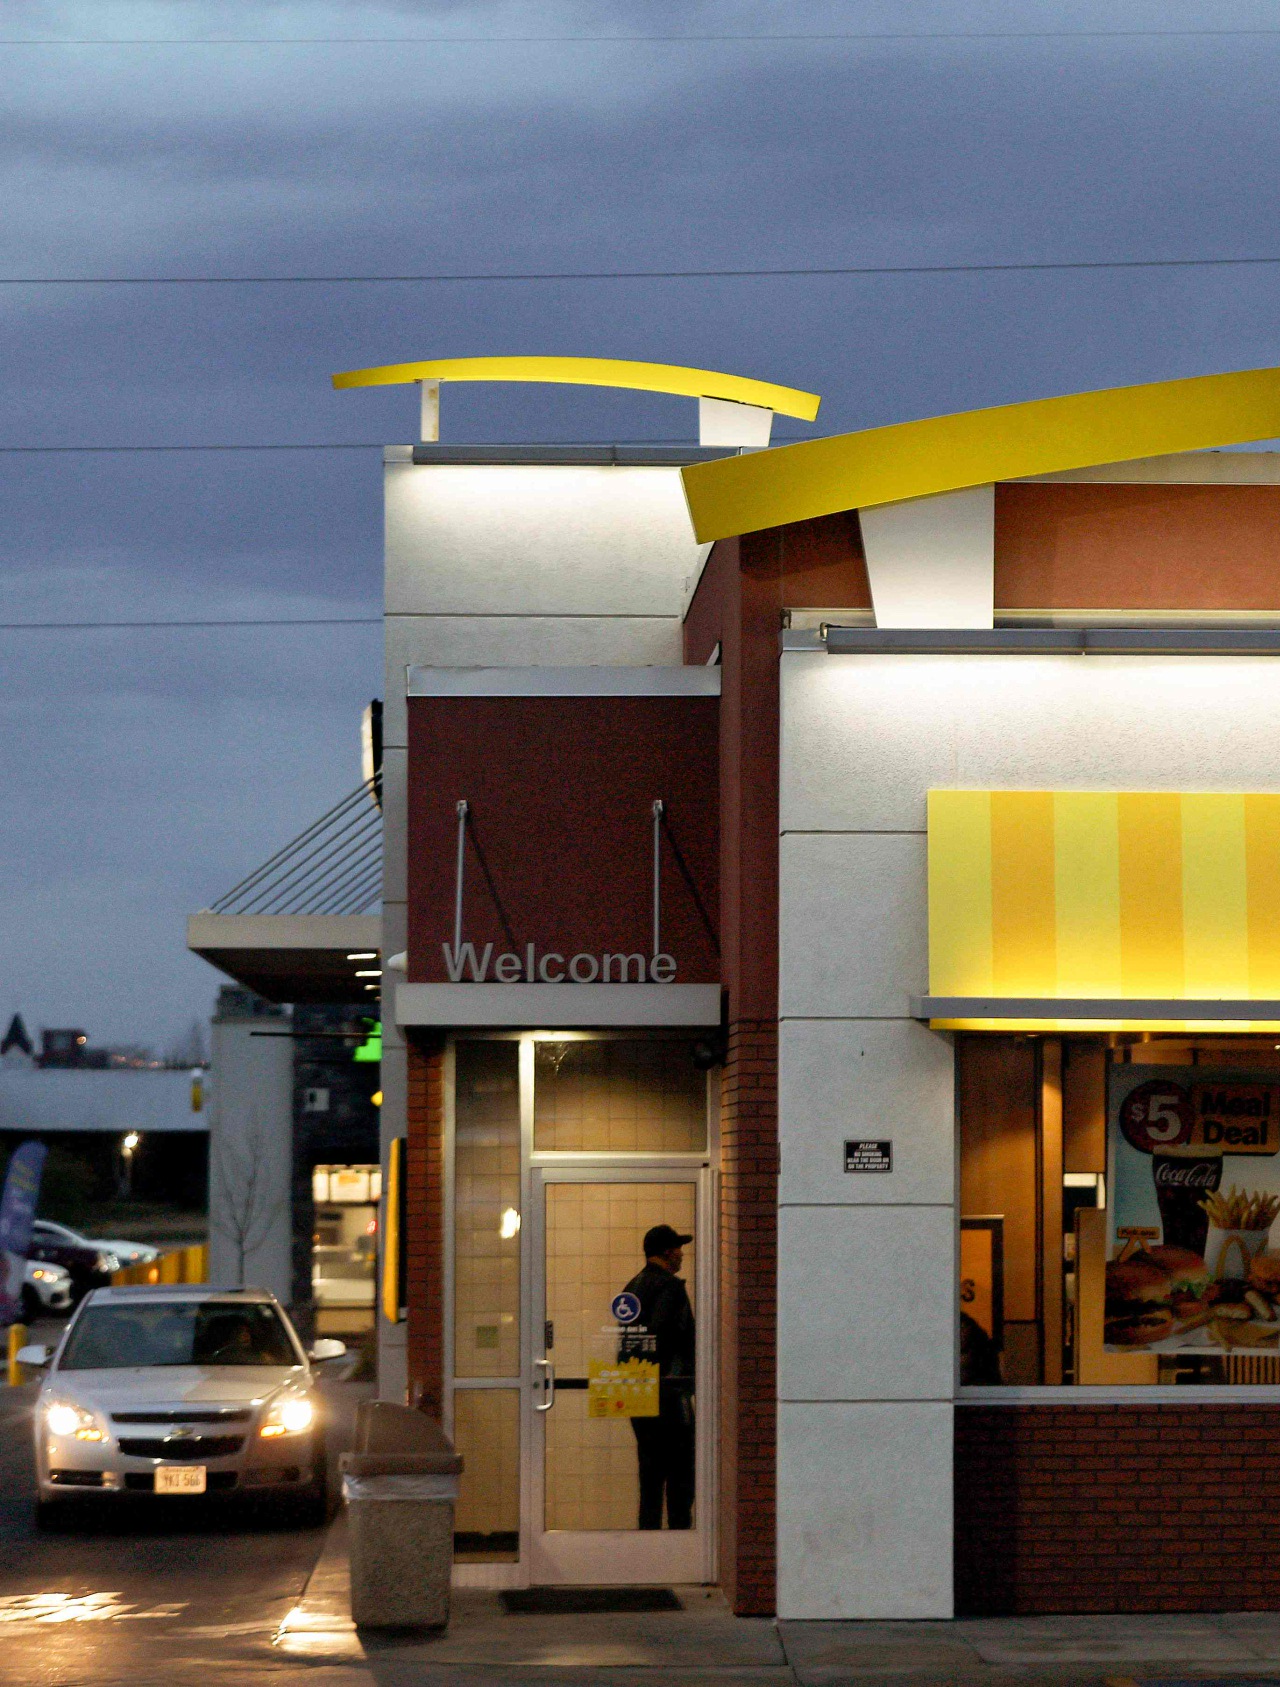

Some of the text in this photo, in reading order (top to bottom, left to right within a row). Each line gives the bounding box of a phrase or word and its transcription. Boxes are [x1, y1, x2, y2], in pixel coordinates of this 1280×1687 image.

[442, 942, 678, 984] Welcome
[1129, 1094, 1183, 1141] $5
[1200, 1091, 1270, 1117] Meal
[1203, 1120, 1268, 1145] Deal
